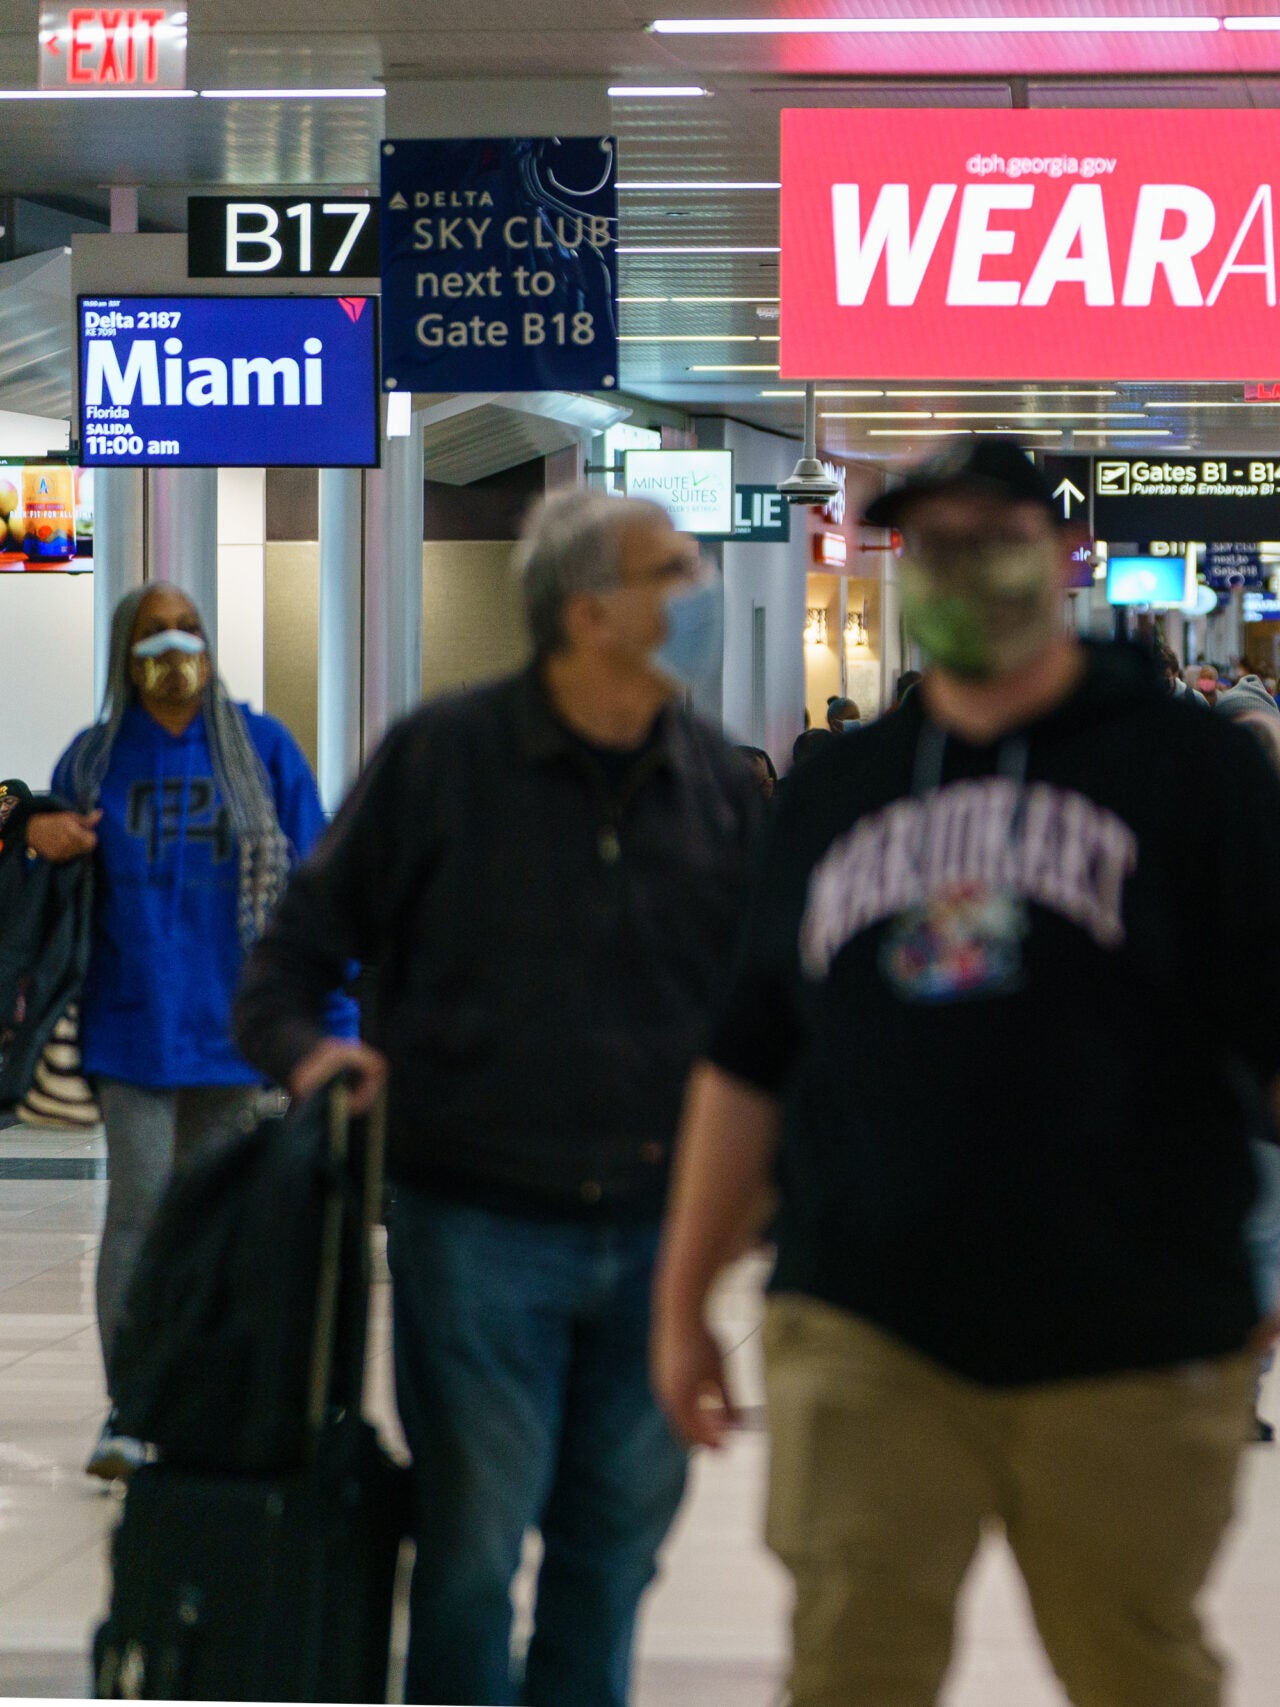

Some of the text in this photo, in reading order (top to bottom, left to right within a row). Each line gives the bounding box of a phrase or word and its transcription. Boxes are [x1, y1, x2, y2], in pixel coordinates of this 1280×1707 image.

[67, 8, 166, 84] EXIT
[966, 153, 1118, 177] dph.georgia.gov
[414, 190, 495, 208] DELTA
[225, 202, 371, 273] B17
[412, 215, 611, 250] SKY CLUB
[415, 265, 556, 297] next to
[85, 311, 181, 329] Delta 2187
[416, 311, 596, 347] Gate B18
[85, 337, 323, 407] Miami
[86, 406, 130, 419] Florida
[86, 423, 134, 435] SALIDA
[86, 435, 180, 455] 11:00 am
[632, 475, 689, 490] MINUTE
[1131, 462, 1197, 483] Gates
[1202, 462, 1227, 482] B1
[671, 488, 718, 504] SUITES
[1132, 482, 1178, 495] Puertas
[1179, 482, 1196, 495] de
[1197, 482, 1258, 497] Embarque
[1260, 482, 1275, 494] B1
